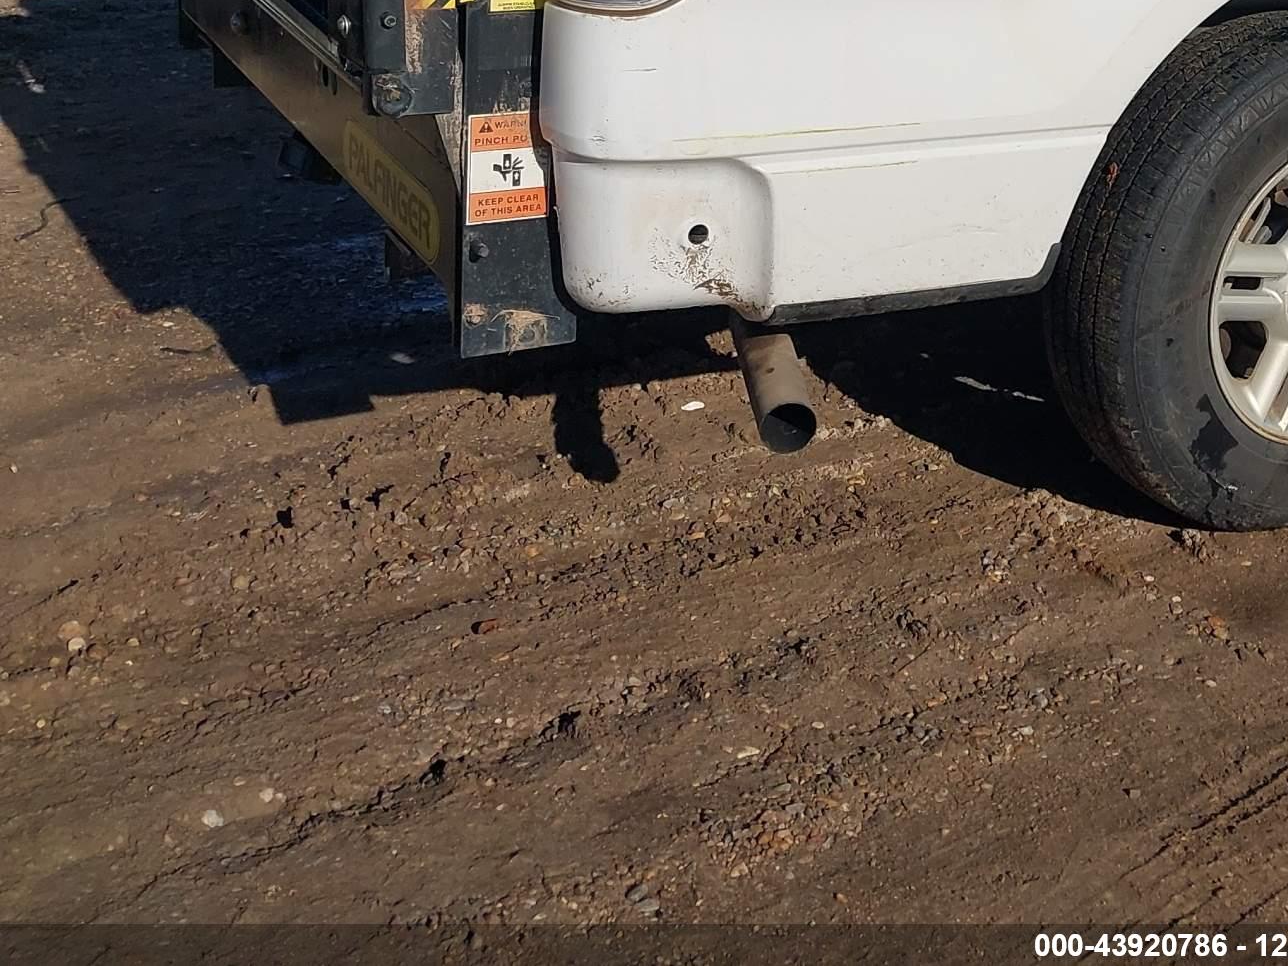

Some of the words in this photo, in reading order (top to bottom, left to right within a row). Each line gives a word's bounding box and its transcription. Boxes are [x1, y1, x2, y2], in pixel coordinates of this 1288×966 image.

[474, 136, 508, 146] PINCH
[348, 132, 430, 250] PALFINGER
[477, 196, 504, 207] KEEP
[507, 193, 540, 204] CLEAR
[474, 208, 488, 218] OF
[490, 205, 513, 216] THIS
[515, 203, 542, 213] AREA
